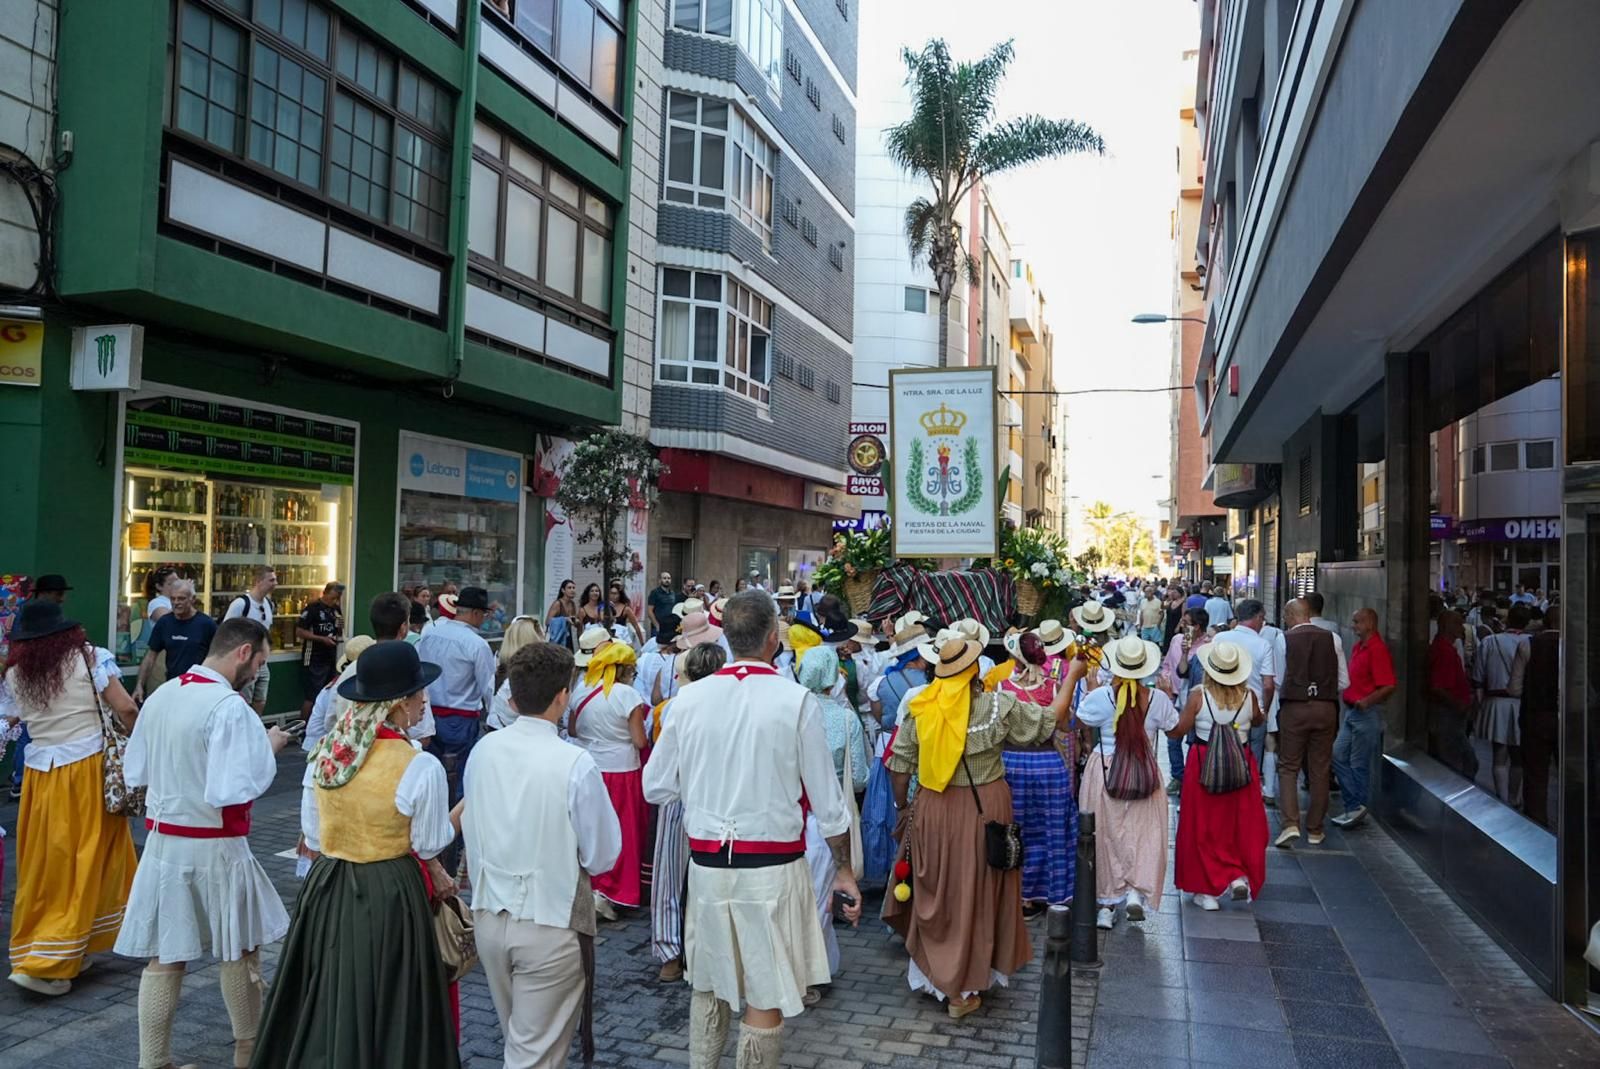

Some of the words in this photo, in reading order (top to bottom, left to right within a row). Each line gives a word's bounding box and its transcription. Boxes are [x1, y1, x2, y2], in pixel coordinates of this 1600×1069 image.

[1, 324, 28, 343] G
[426, 461, 461, 477] Lebara
[851, 477, 881, 486] RAYO
[850, 486, 880, 495] GOLD
